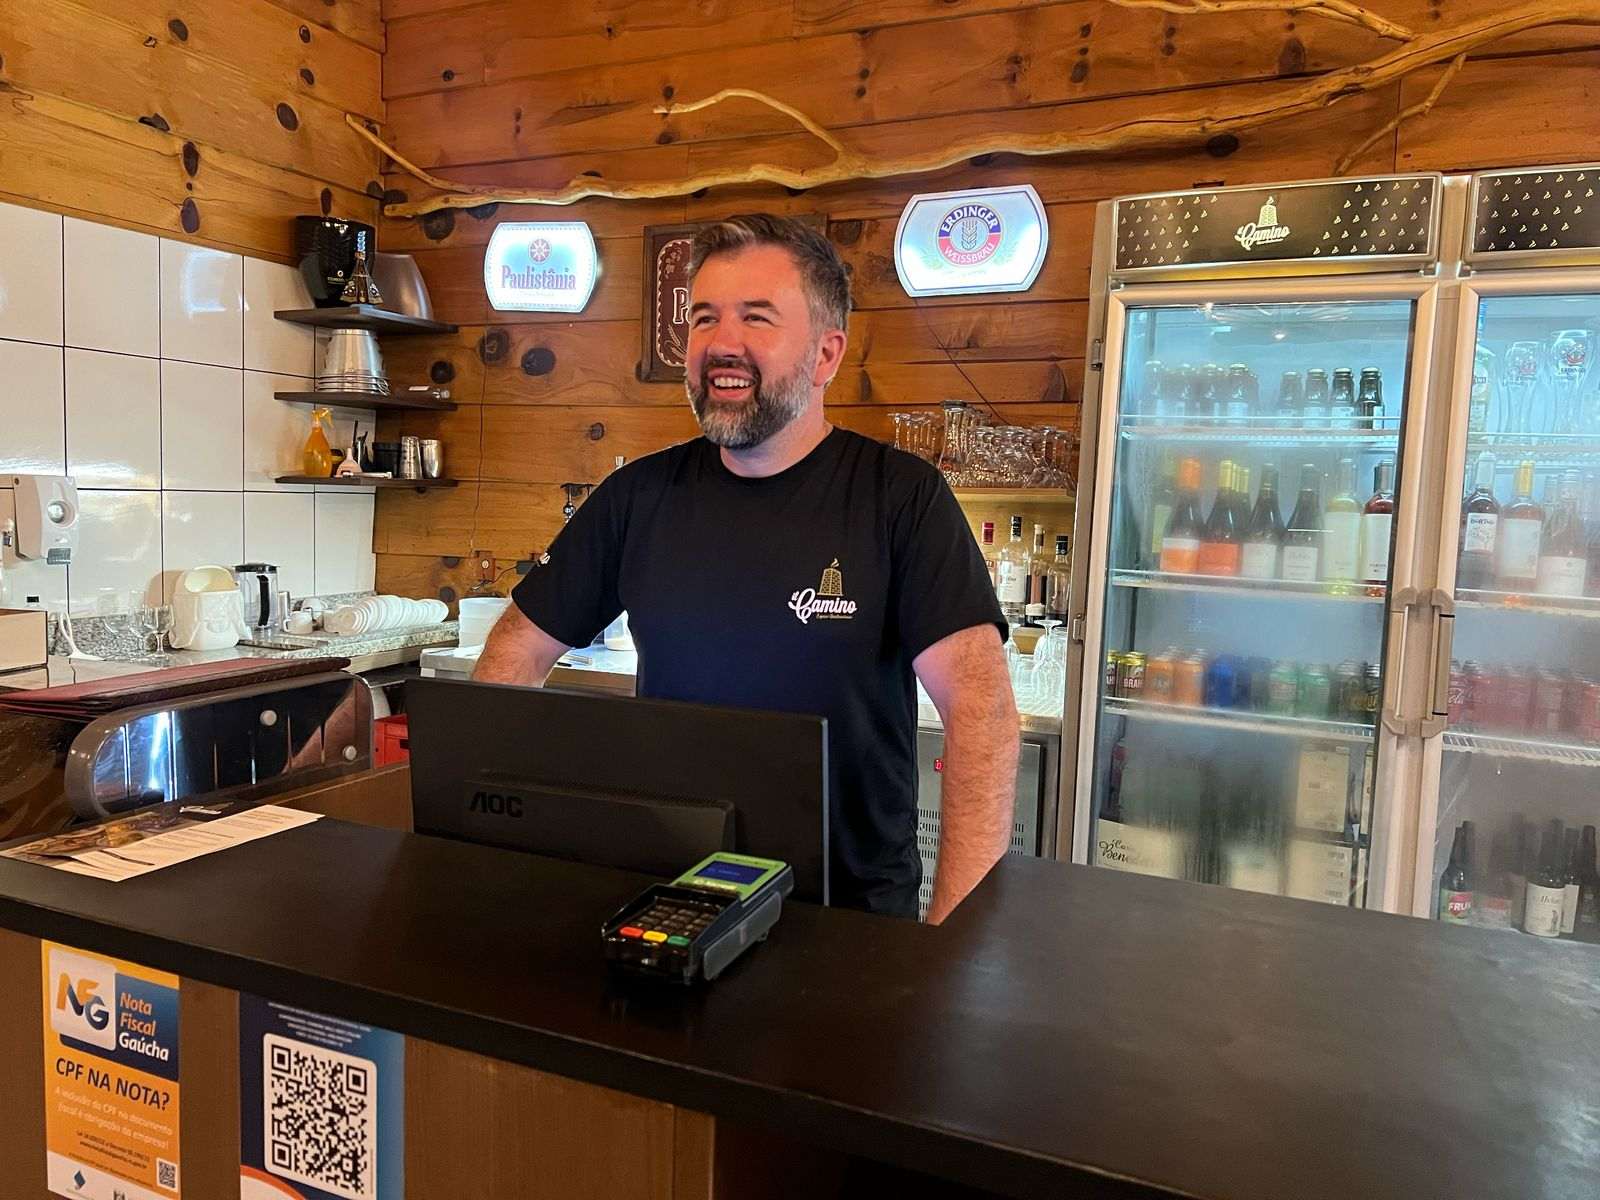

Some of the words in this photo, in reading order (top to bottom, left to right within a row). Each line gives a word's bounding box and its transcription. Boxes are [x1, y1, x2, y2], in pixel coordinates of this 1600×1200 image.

[941, 205, 999, 232] ERDINGER
[1234, 222, 1291, 251] Camino
[501, 265, 577, 290] Paulistânia
[672, 287, 690, 325] P
[787, 588, 858, 625] Camino
[469, 791, 523, 818] AOC
[119, 992, 152, 1016] Nota
[120, 1012, 156, 1037] Fiscal
[118, 1032, 169, 1061] Gaúcha
[56, 1057, 84, 1081] CPF
[87, 1068, 111, 1092] NA
[115, 1077, 170, 1111] NOTA?
